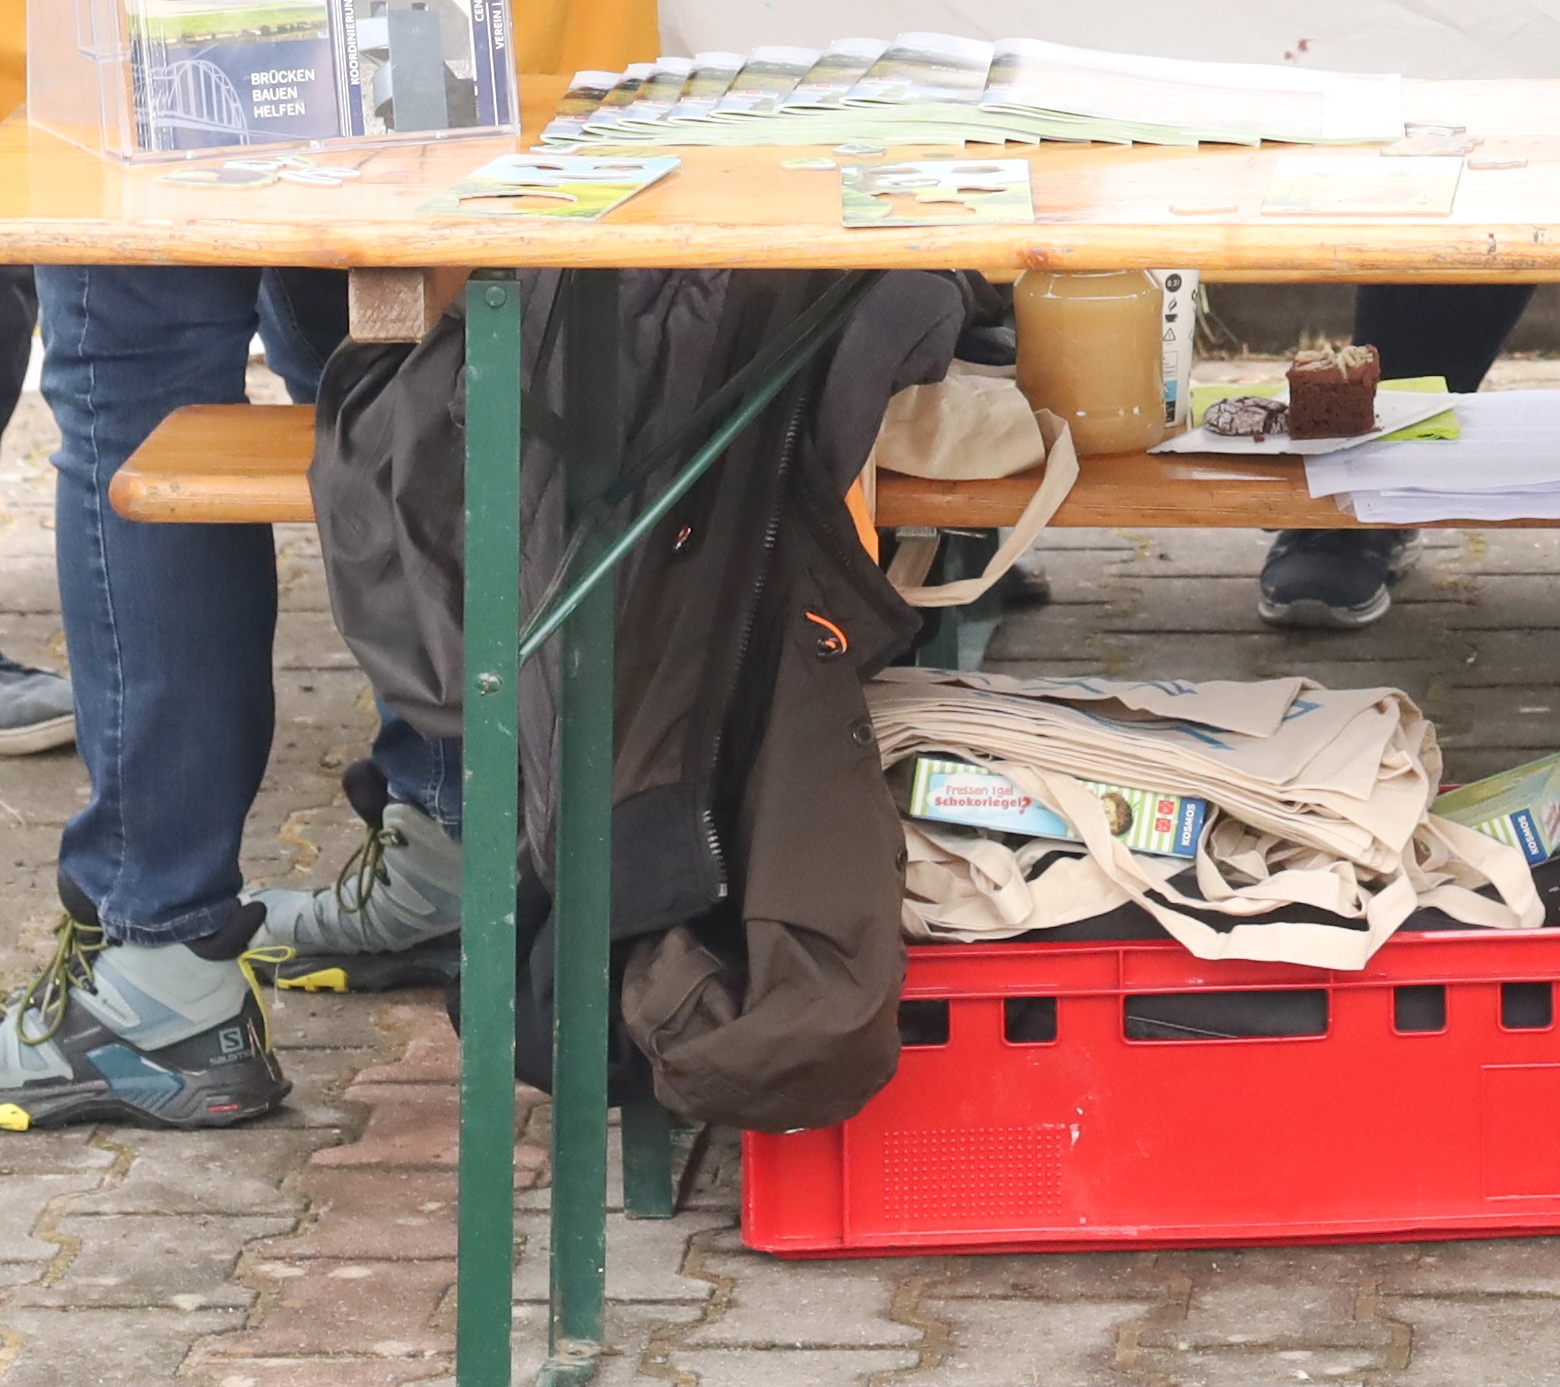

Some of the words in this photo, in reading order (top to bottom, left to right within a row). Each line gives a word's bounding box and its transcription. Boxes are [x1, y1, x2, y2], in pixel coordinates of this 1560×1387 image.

[494, 10, 505, 50] VEREIN
[251, 69, 315, 85] BRÜCKEN
[252, 86, 298, 102] BAUEN
[254, 102, 306, 118] HELFEN
[946, 785, 988, 796] Fressen
[992, 784, 1013, 797] Igel
[935, 795, 1032, 815] Schokoriegel?
[1181, 802, 1196, 847] KOSMOS
[1517, 815, 1541, 857] KOSMOS
